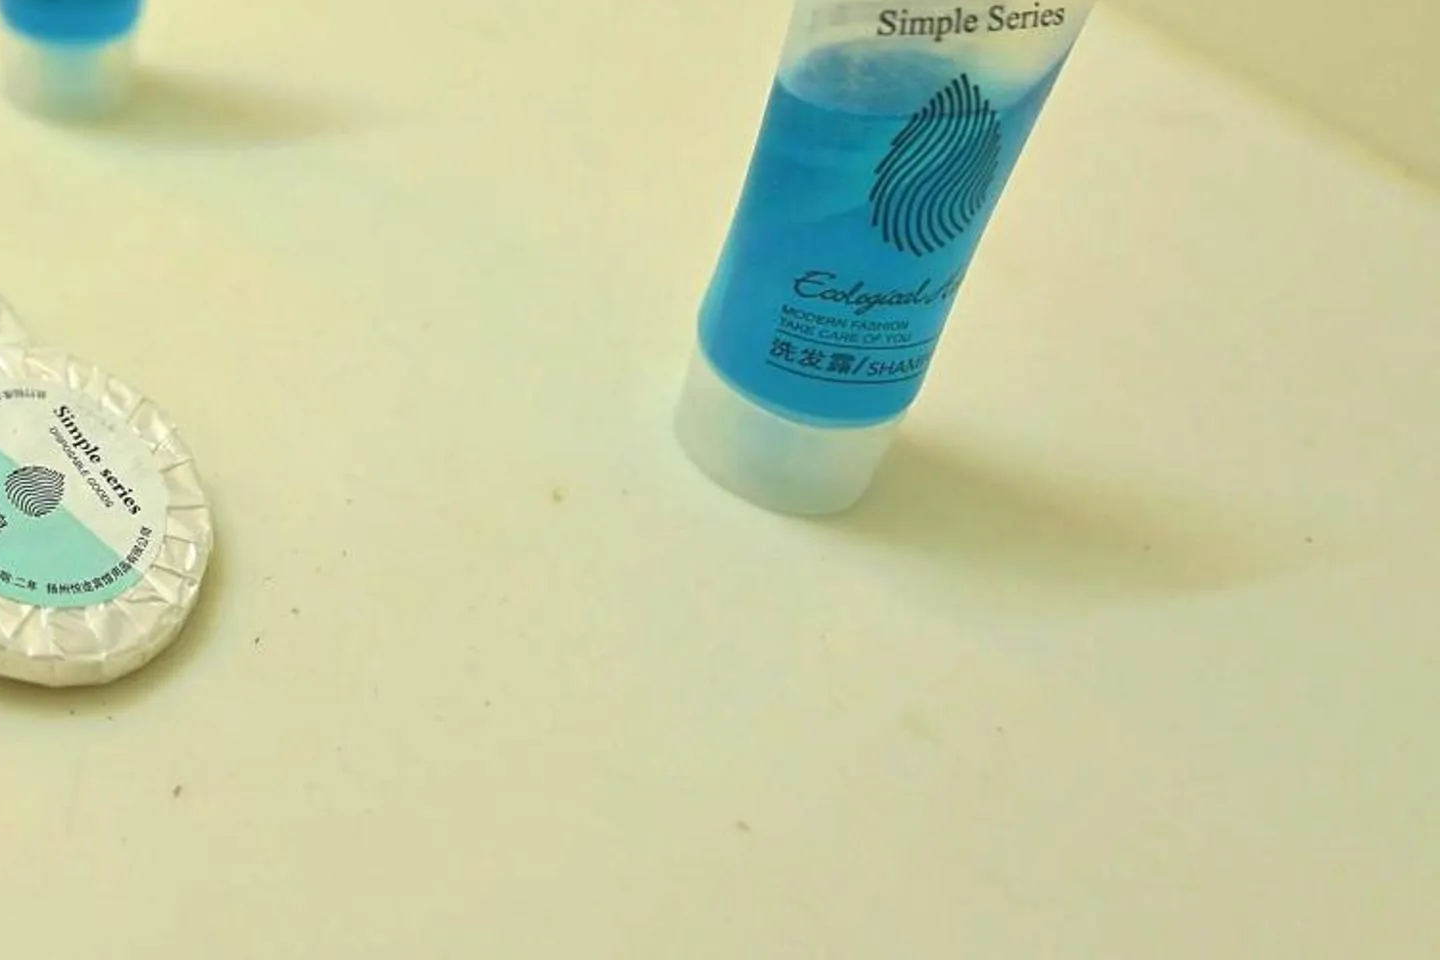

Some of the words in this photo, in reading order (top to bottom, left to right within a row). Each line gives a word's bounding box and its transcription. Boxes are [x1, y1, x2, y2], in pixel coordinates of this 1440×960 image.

[877, 7, 978, 42] Simple
[987, 1, 1066, 32] Series
[779, 316, 816, 337] TAKE
[819, 329, 860, 344] CARE
[780, 303, 848, 330] MODERN
[850, 319, 911, 332] FASHION
[53, 404, 101, 465] Simple
[100, 467, 142, 517] series
